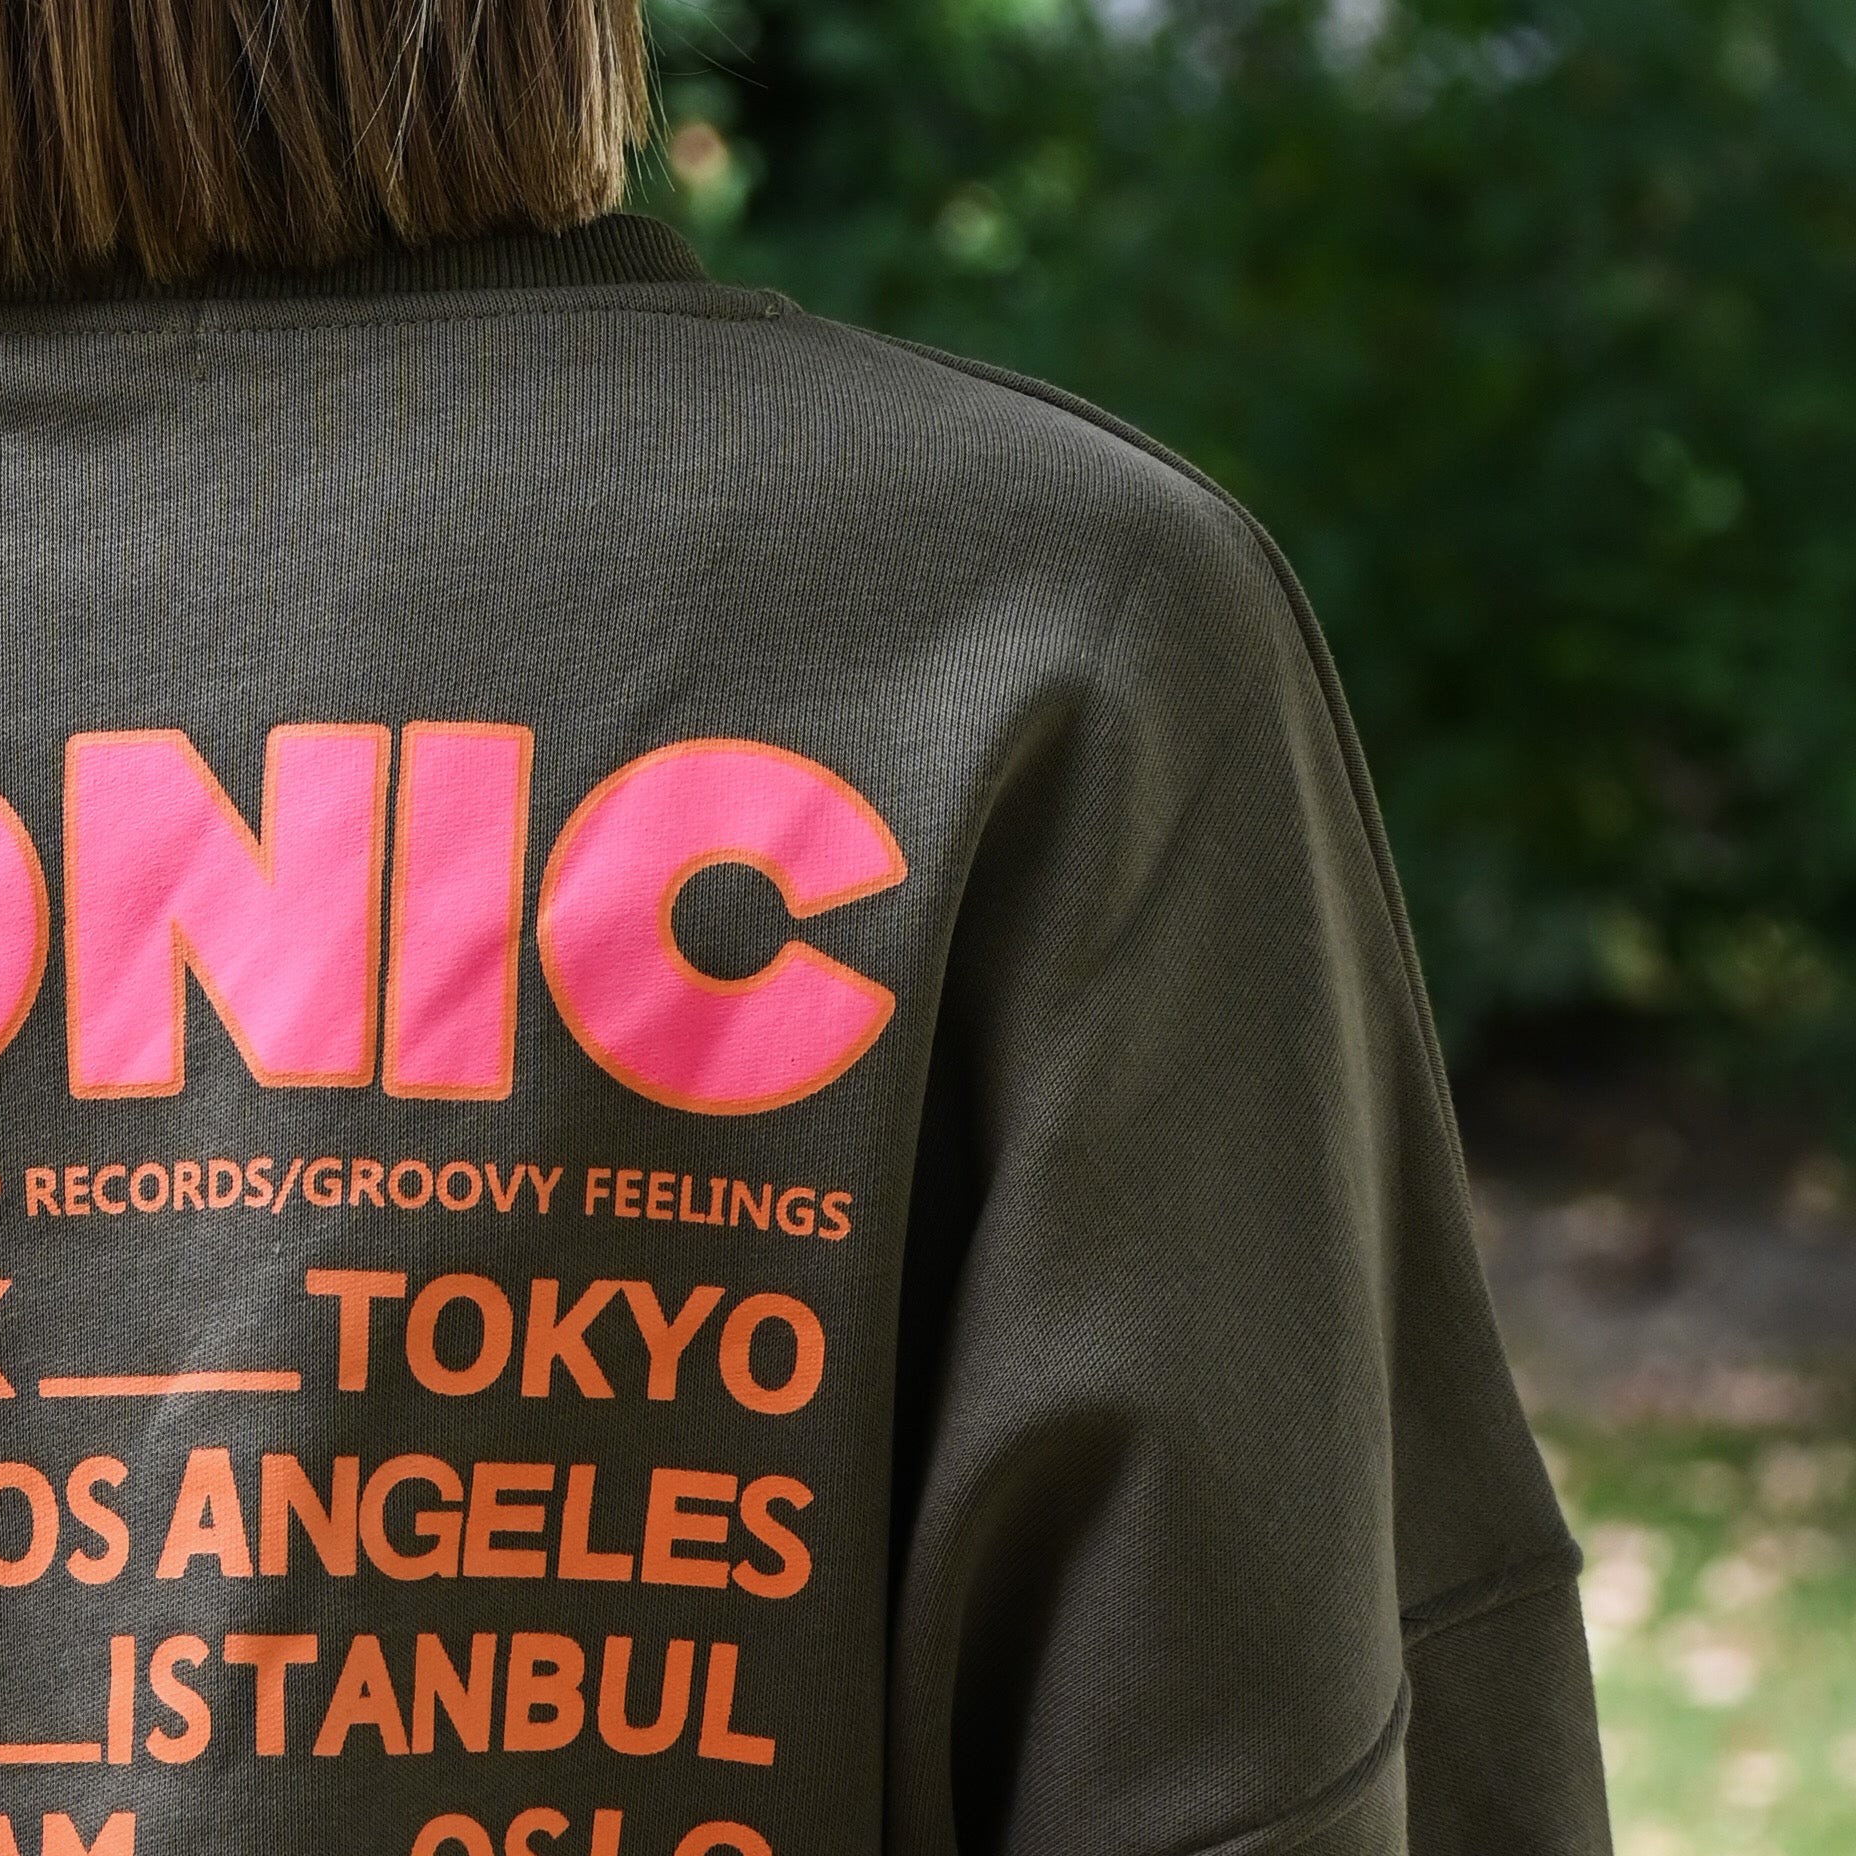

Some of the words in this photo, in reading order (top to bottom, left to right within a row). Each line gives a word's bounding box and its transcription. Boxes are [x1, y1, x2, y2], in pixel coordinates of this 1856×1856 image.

[585, 1168, 855, 1242] FEELINGS
[305, 1268, 827, 1417] TOKYO
[156, 1447, 816, 1601] ANGELES
[107, 1632, 778, 1767] ISTANBUL
